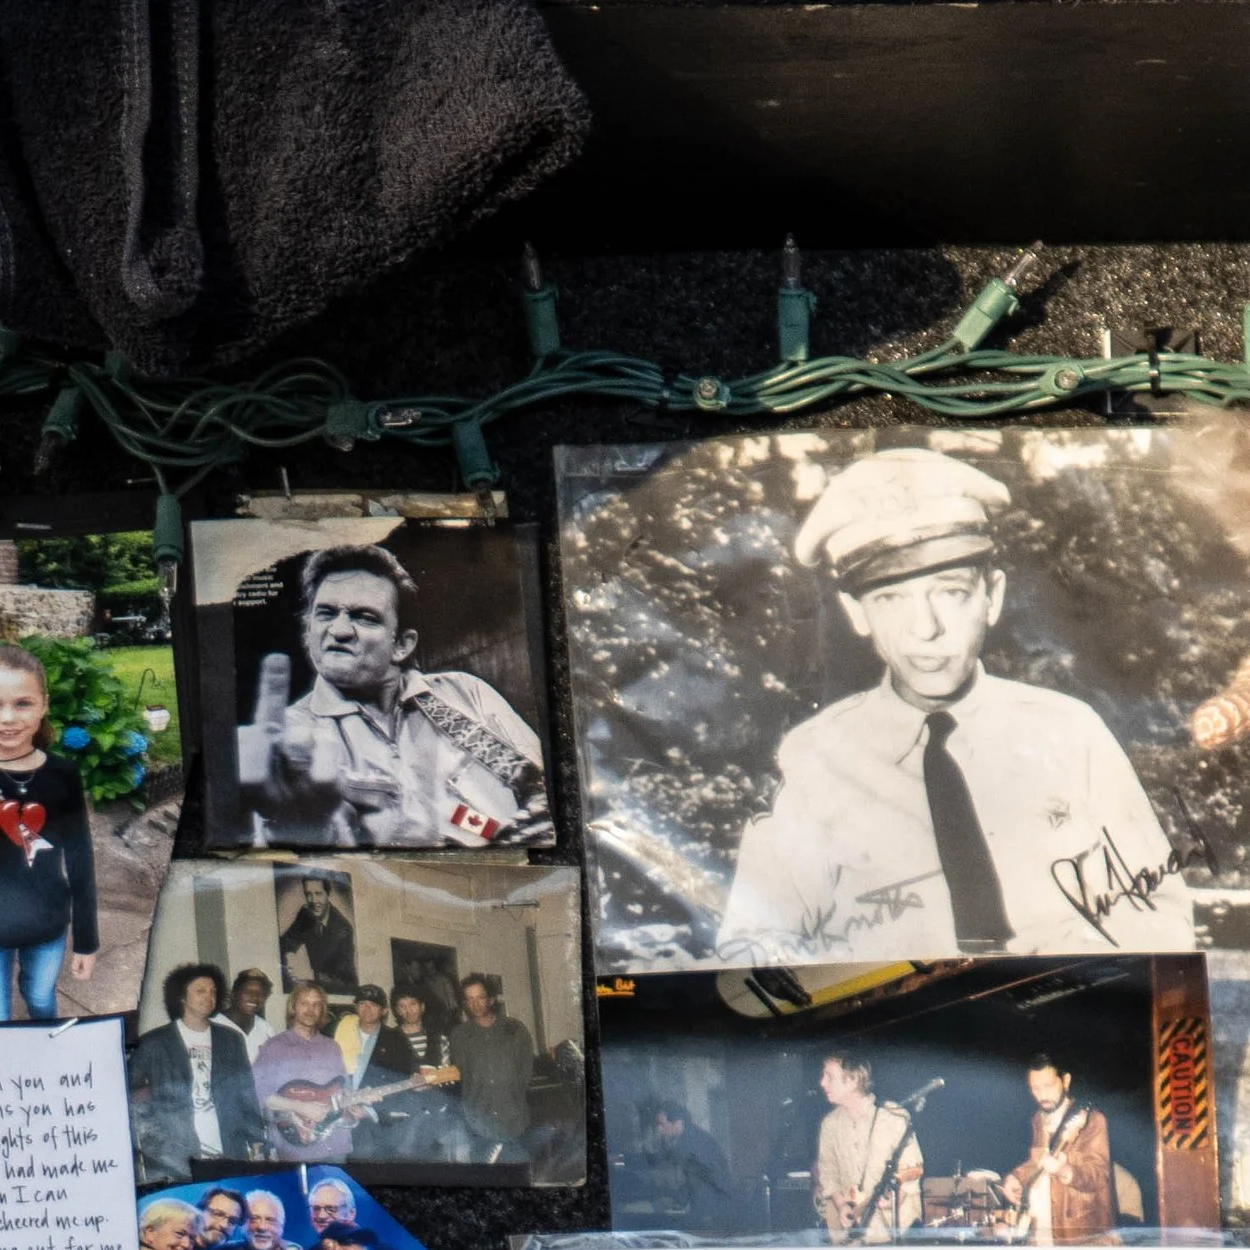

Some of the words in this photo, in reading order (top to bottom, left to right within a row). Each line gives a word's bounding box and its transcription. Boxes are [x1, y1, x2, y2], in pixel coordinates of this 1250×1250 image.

[11, 1075, 45, 1100] you
[59, 1061, 92, 1091] and
[1172, 1038, 1193, 1130] CAUTION
[43, 1126, 58, 1150] of
[63, 1124, 98, 1146] this
